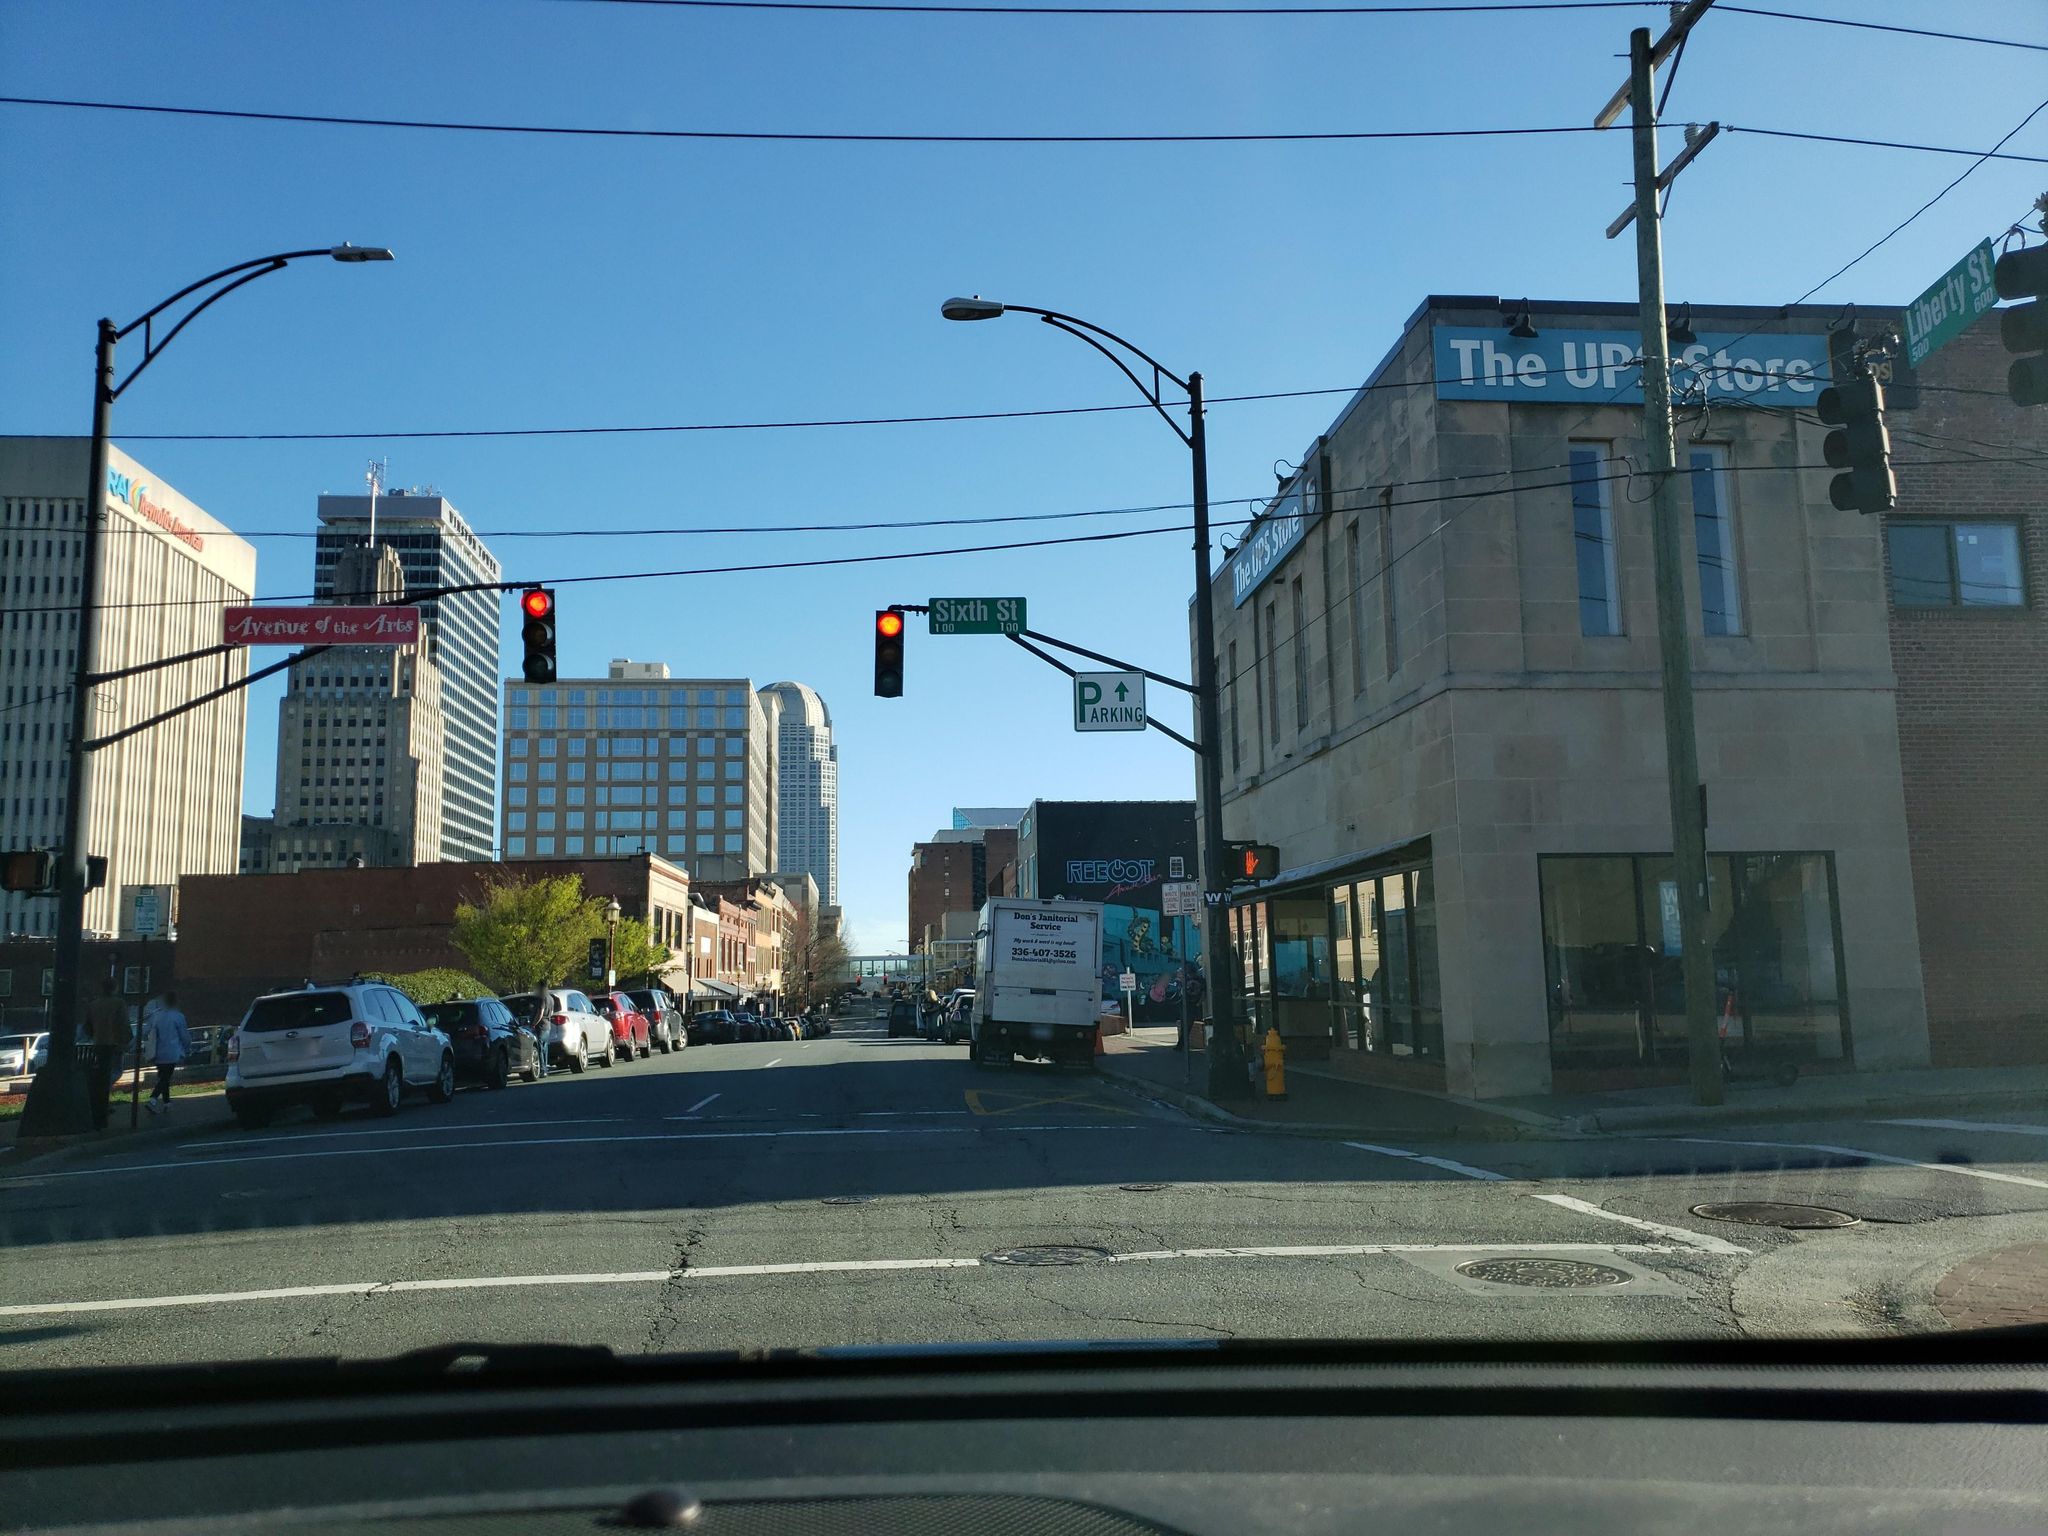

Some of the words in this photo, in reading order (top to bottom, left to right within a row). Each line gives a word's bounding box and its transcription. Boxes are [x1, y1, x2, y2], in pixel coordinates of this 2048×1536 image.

[1906, 273, 1965, 345] Liberty
[1967, 248, 1990, 294] St
[1973, 286, 1993, 313] 600
[1911, 338, 1930, 362] 500
[1449, 339, 1547, 387] The
[1681, 345, 1816, 393] Store
[106, 464, 129, 505] RAI
[140, 493, 174, 532] Reynolds
[172, 517, 205, 553] American
[1234, 561, 1251, 597] The
[1252, 529, 1271, 578] UPS
[1272, 506, 1300, 556] Store
[935, 599, 988, 622] Sixth
[996, 599, 1018, 622] St
[229, 615, 309, 637] Avenue
[315, 615, 332, 632] of
[334, 622, 358, 635] the
[363, 614, 414, 635] Arts
[935, 623, 955, 633] 100
[1000, 622, 1019, 633] 100
[1078, 681, 1143, 723] PARKING
[1013, 912, 1037, 921] Don's
[1038, 913, 1078, 923] Janitorial
[1030, 921, 1062, 931] Service
[1012, 947, 1077, 959] 336-407-3526
